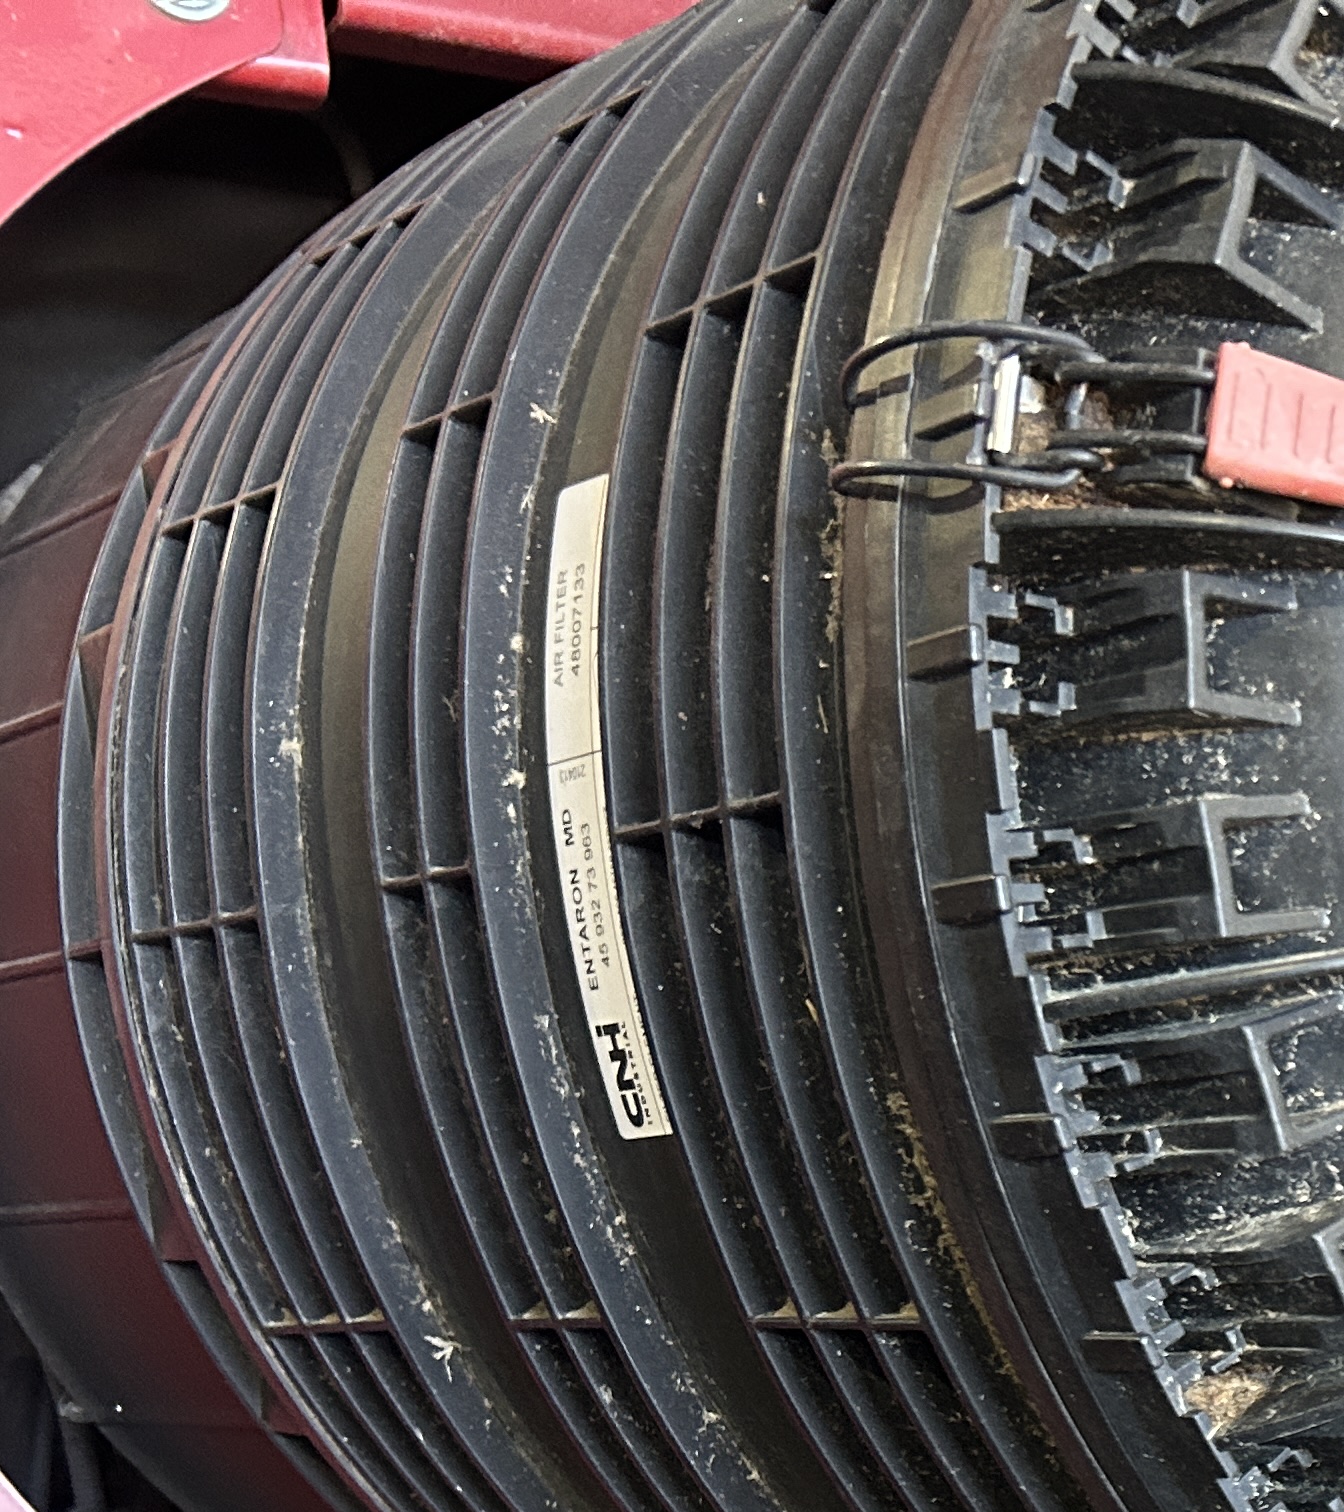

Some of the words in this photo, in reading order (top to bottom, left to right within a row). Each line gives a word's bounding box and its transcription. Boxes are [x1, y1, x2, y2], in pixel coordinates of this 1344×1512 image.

[554, 569, 568, 643] FILTER
[571, 562, 586, 677] 48007133
[553, 651, 564, 687] AIR
[562, 808, 576, 847] MD
[580, 822, 594, 862] 963
[587, 866, 598, 892] 73
[568, 868, 599, 991] ENTARON
[591, 898, 605, 937] 932
[599, 942, 611, 967] 45
[621, 1021, 653, 1125] INDUSTRIAL
